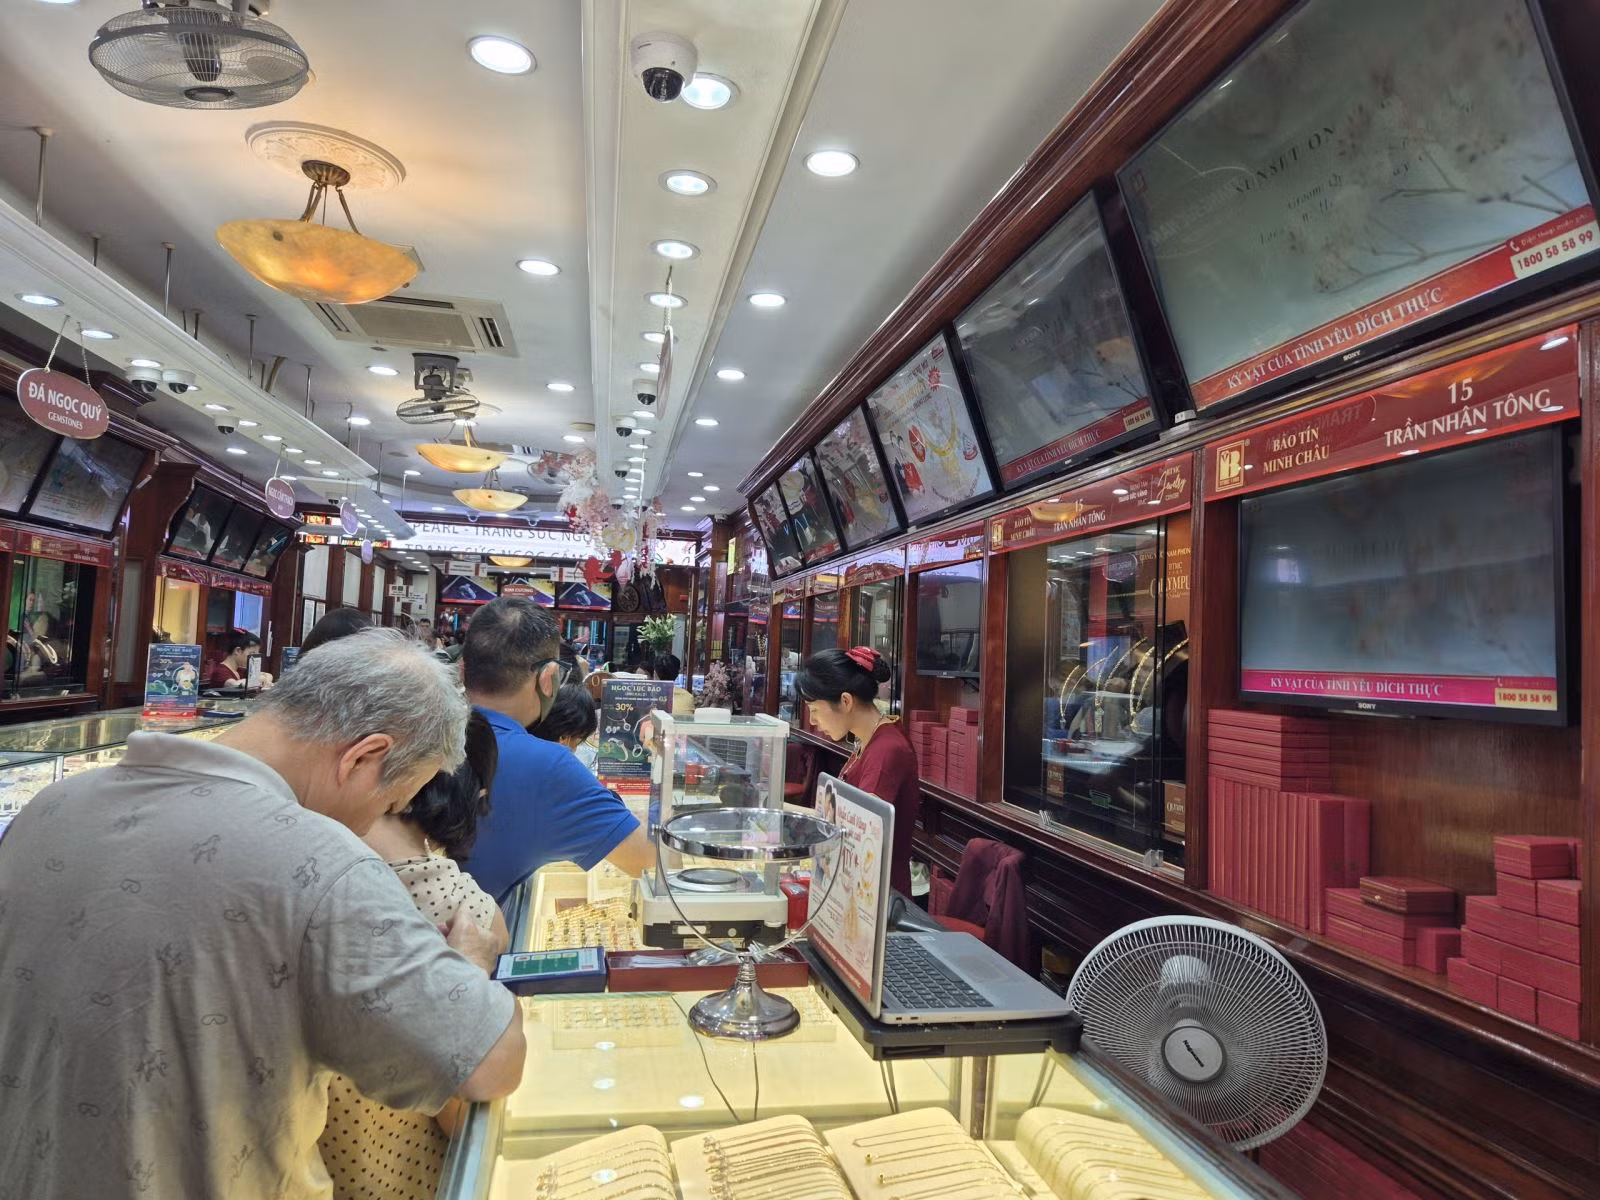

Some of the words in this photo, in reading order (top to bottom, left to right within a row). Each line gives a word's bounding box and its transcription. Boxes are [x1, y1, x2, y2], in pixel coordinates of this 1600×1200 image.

[1517, 251, 1543, 270] 1800
[1545, 245, 1559, 258] 58
[1562, 238, 1576, 251] 58
[1578, 230, 1593, 245] 99
[1243, 364, 1267, 383] VẬT
[1267, 351, 1293, 372] CỦA
[1324, 323, 1354, 348] YÊU
[1355, 313, 1394, 336] ĐÍCH
[1394, 287, 1443, 318] THỰC
[1343, 350, 1361, 361] SONY
[28, 381, 45, 402] ĐÁ
[47, 388, 79, 414] NGỌC
[80, 402, 102, 421] QUÝ
[1448, 377, 1474, 404] 15
[47, 411, 83, 430] GEMSTONES
[1384, 417, 1427, 447] TRẦN
[1432, 405, 1487, 435] NHÂN
[1492, 388, 1551, 420] TÔNG
[1273, 431, 1297, 452] BẢO
[1298, 425, 1319, 444] TÍN
[1263, 454, 1293, 474] MINH
[1295, 444, 1330, 466] CHÂU
[1075, 499, 1084, 512] 15
[1088, 509, 1106, 524] TÔNG
[413, 523, 459, 534] PEARL
[475, 527, 523, 539] TRANG
[562, 532, 593, 547] NGỌ
[615, 702, 634, 711] 30%
[1358, 702, 1376, 710] SONY
